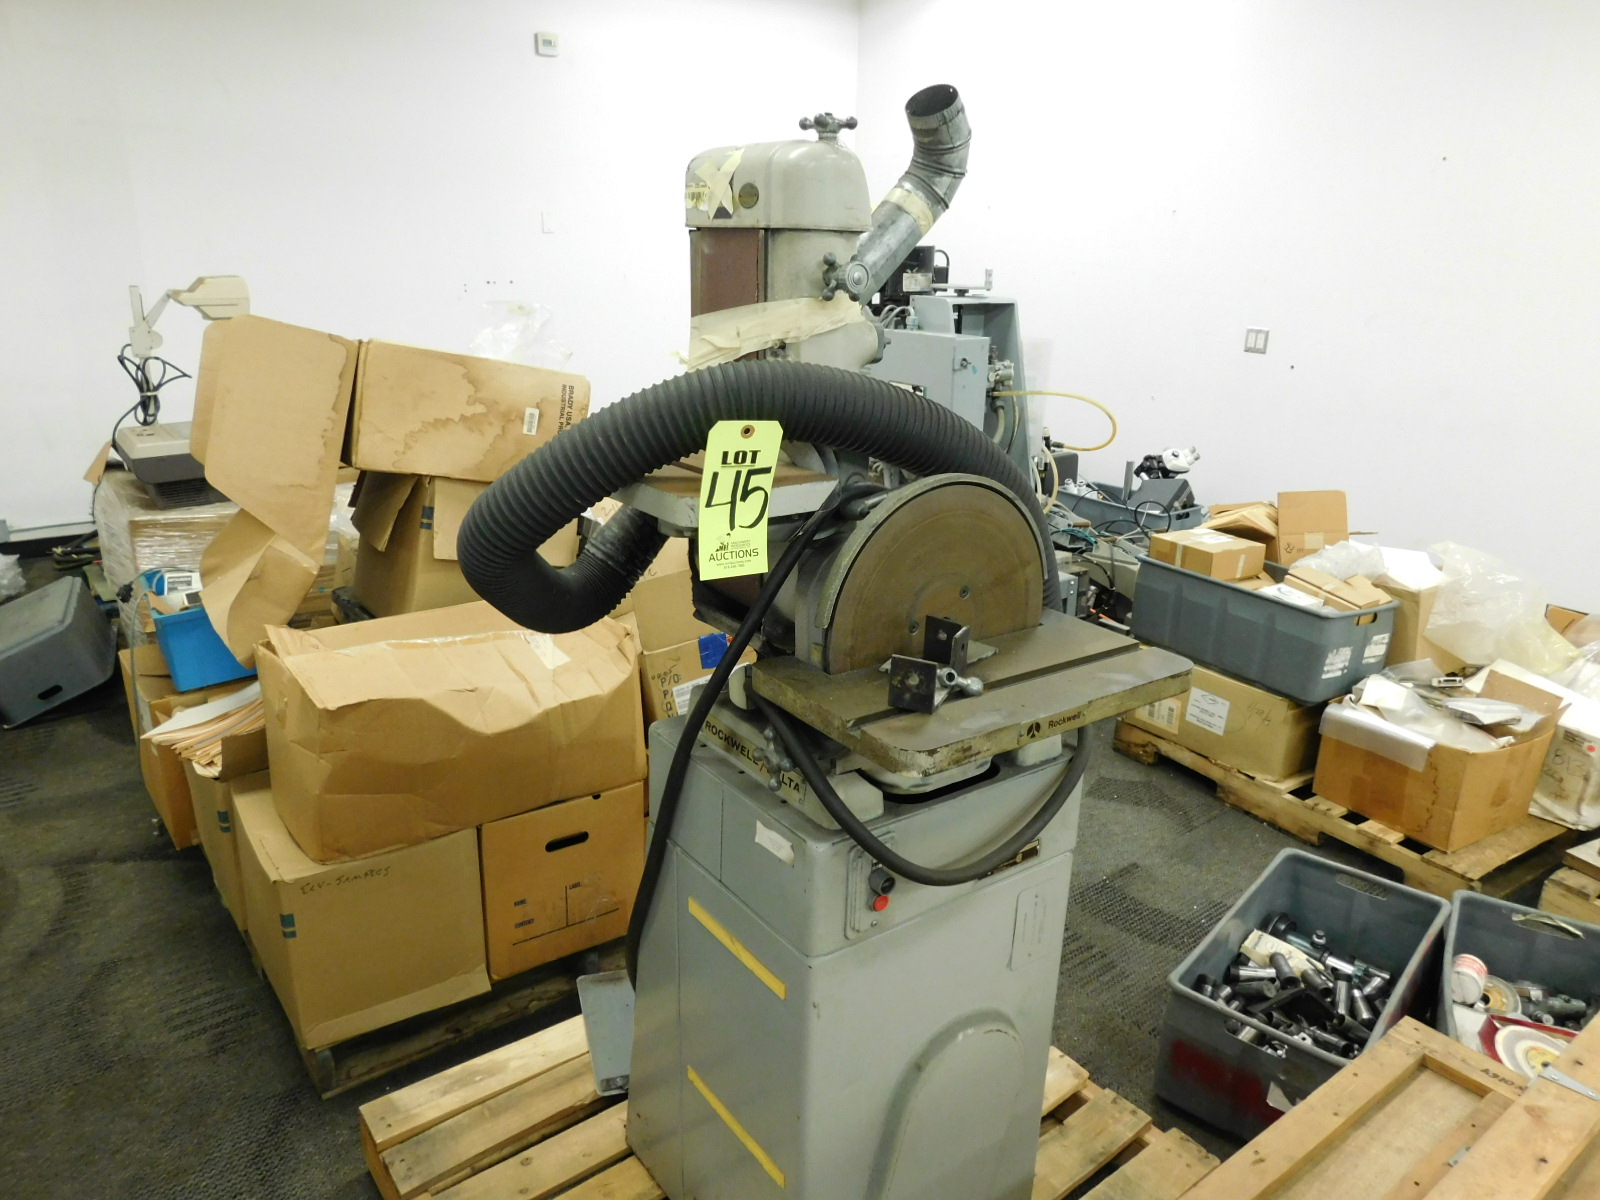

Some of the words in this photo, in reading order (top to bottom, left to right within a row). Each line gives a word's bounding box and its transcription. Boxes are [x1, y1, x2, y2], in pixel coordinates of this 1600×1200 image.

[559, 384, 567, 420] INDUSTRIAL
[567, 385, 575, 410] BRADY
[721, 449, 762, 466] LOT
[705, 466, 772, 531] 45
[708, 547, 759, 563] AUCTIONS
[1048, 711, 1082, 729] Rockwell
